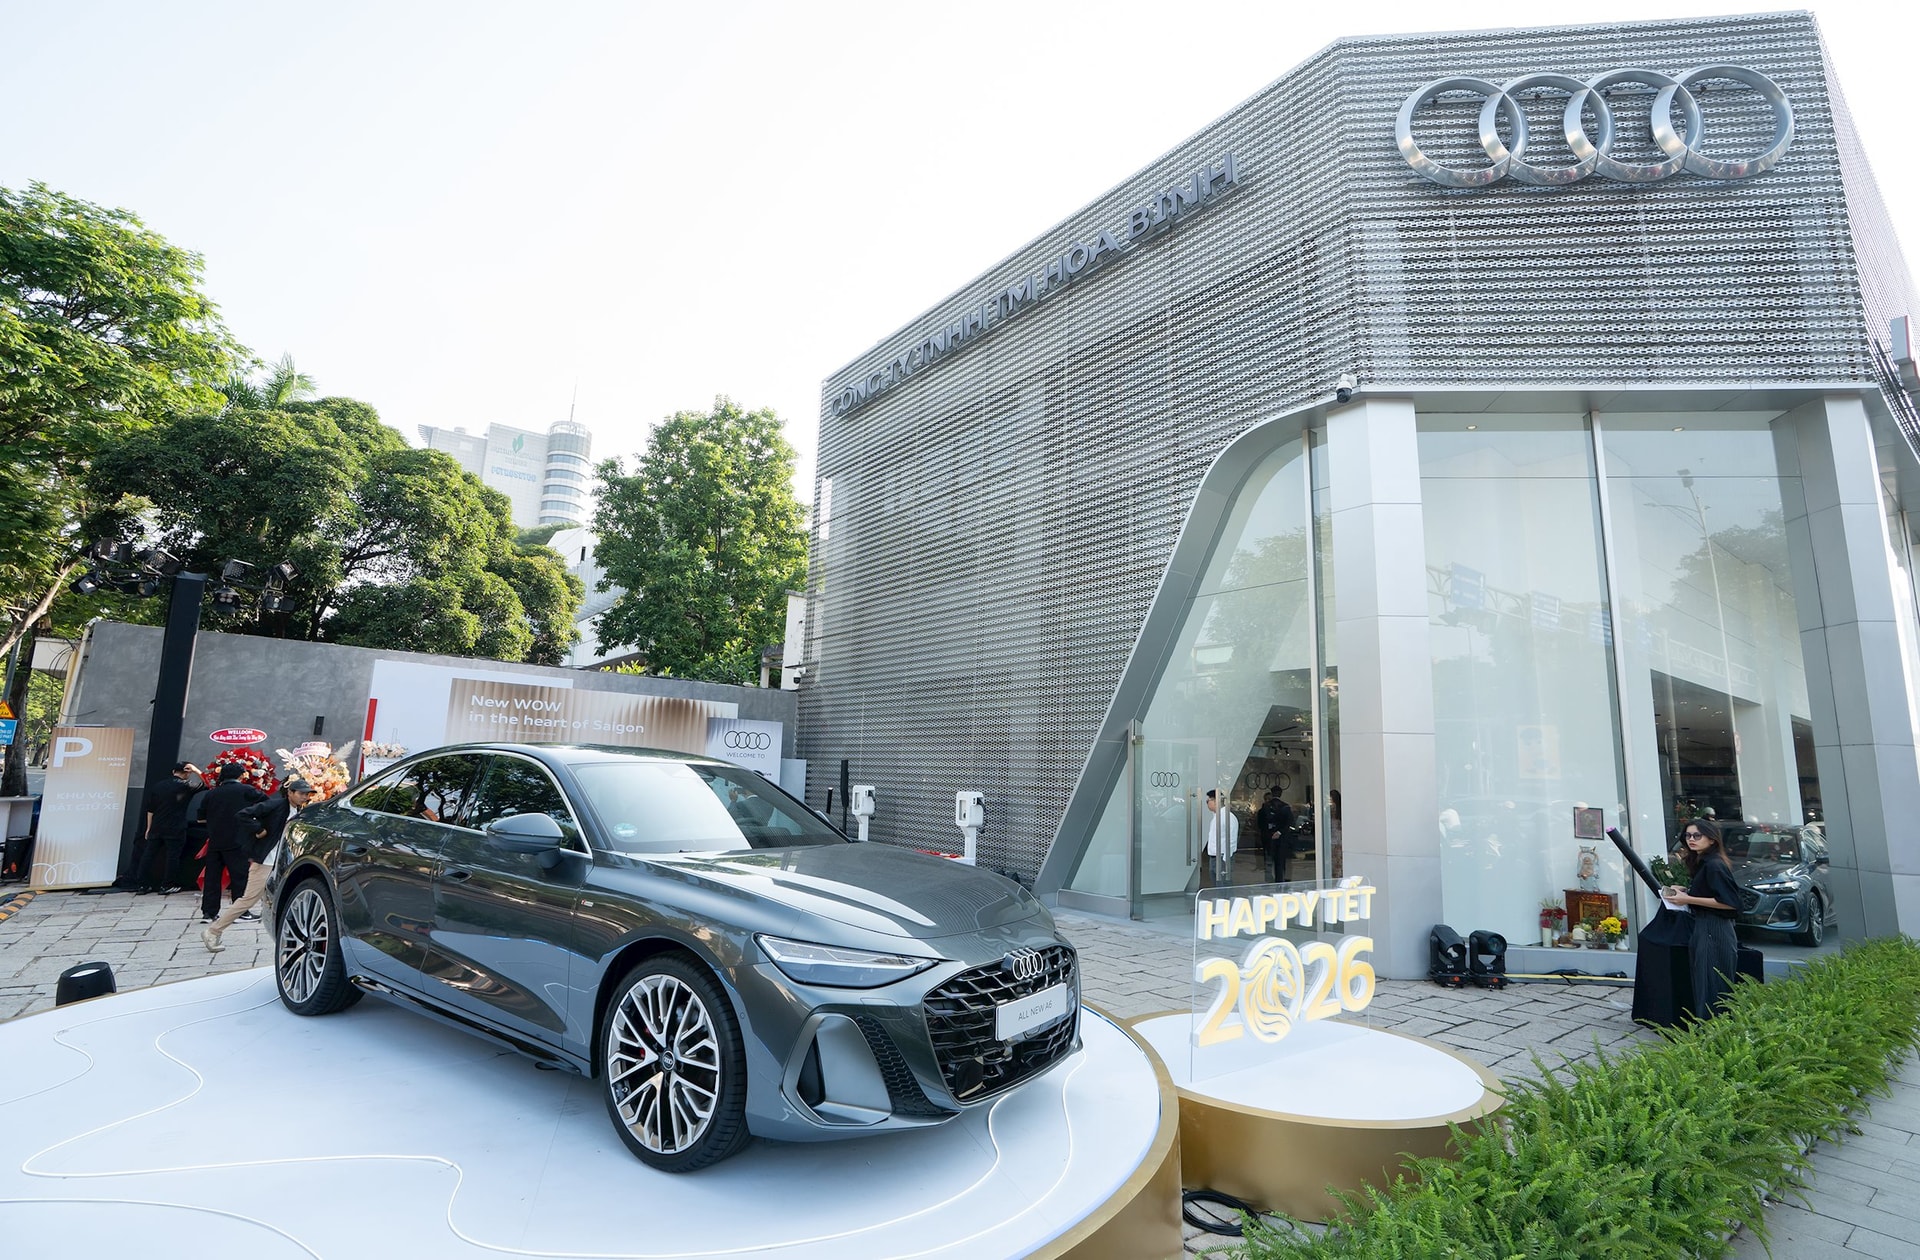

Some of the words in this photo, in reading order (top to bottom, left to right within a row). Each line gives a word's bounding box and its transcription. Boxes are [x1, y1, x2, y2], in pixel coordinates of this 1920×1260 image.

[886, 349, 914, 383] TY
[917, 305, 988, 364] TNHH
[991, 273, 1039, 322] TM
[471, 695, 509, 708] New
[514, 698, 562, 712] WOW
[469, 710, 485, 722] in
[490, 712, 519, 725] the
[523, 714, 567, 728] heart
[572, 719, 589, 729] of
[592, 719, 644, 735] Saigon
[53, 737, 93, 768] P
[1198, 891, 1320, 940] HAPPY
[1320, 876, 1376, 924] TẾT
[1018, 1010, 1029, 1020] ALL
[1031, 1003, 1045, 1016] NEW
